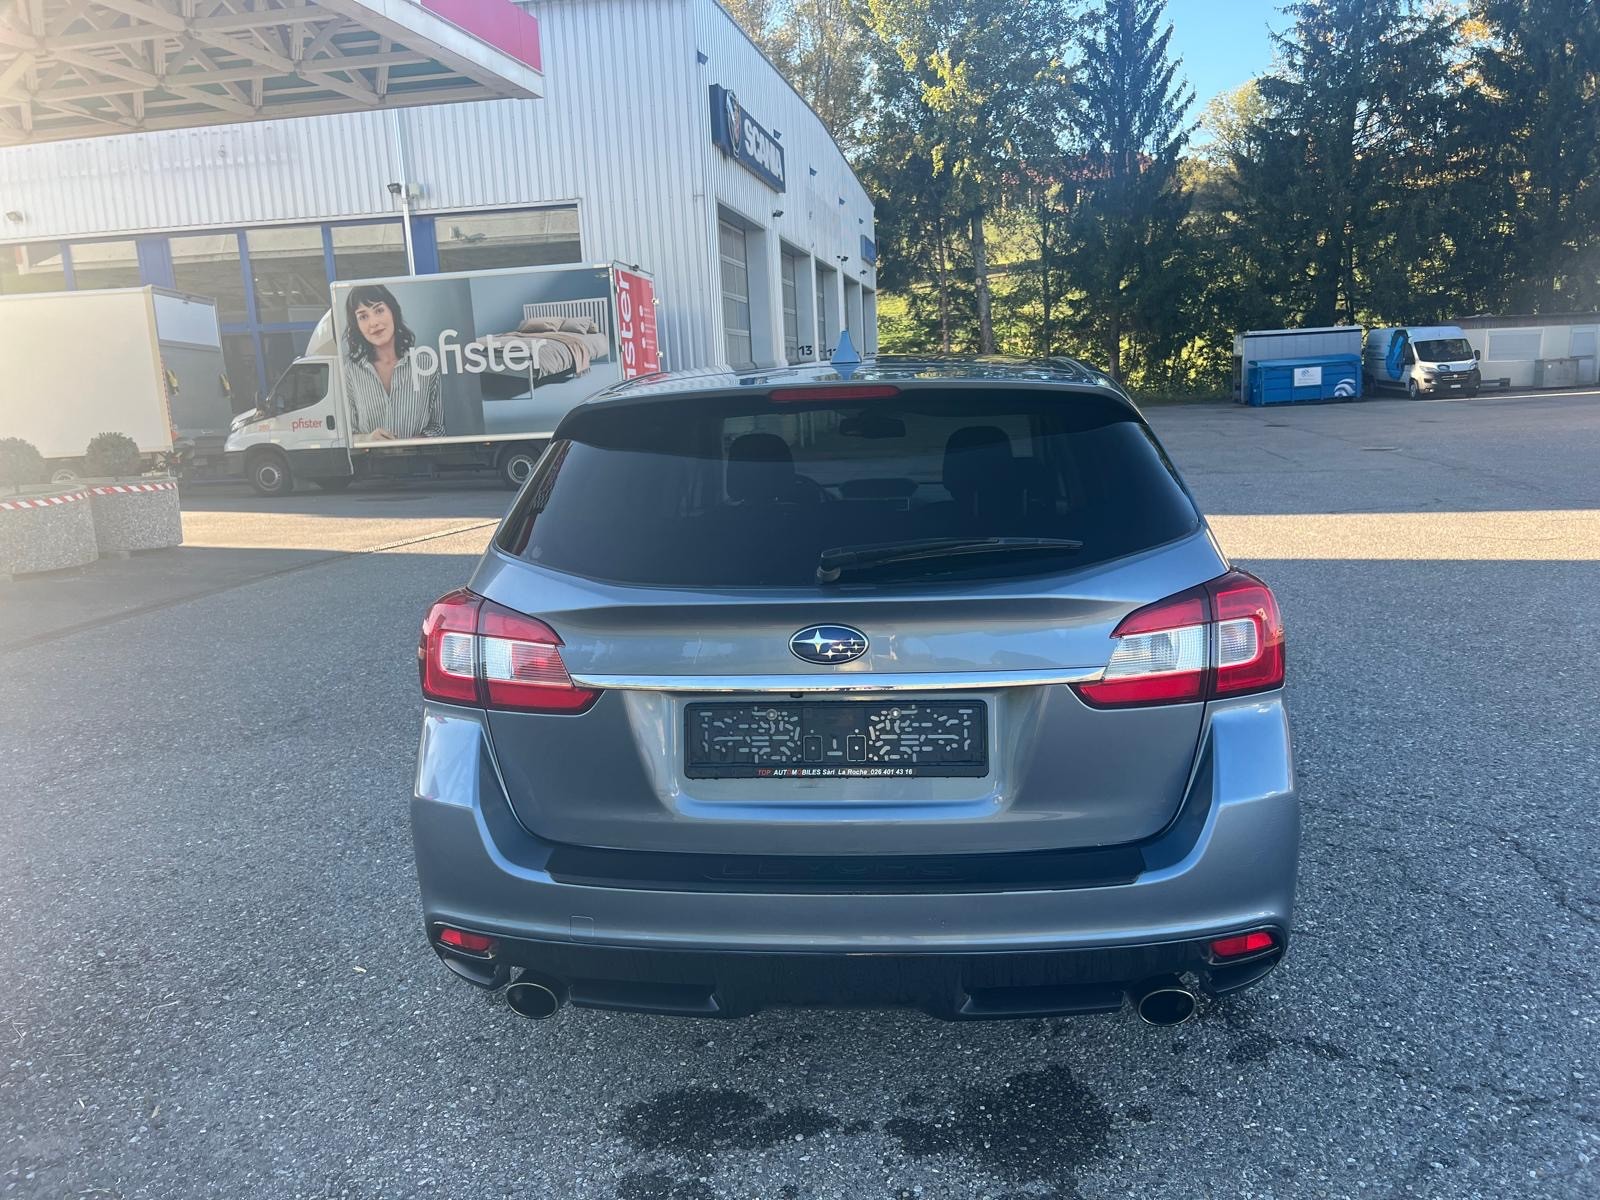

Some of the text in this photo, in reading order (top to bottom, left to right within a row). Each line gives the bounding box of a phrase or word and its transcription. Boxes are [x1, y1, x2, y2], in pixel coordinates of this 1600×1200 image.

[743, 118, 784, 182] SCANIA
[798, 345, 813, 356] 13
[408, 328, 548, 392] pfister
[291, 418, 322, 432] pfister
[773, 768, 821, 776] AUTOMOBILES
[837, 768, 846, 776] La
[847, 768, 868, 776] Roche
[870, 768, 881, 776] 026
[882, 768, 894, 776] 401
[895, 768, 904, 776] 43
